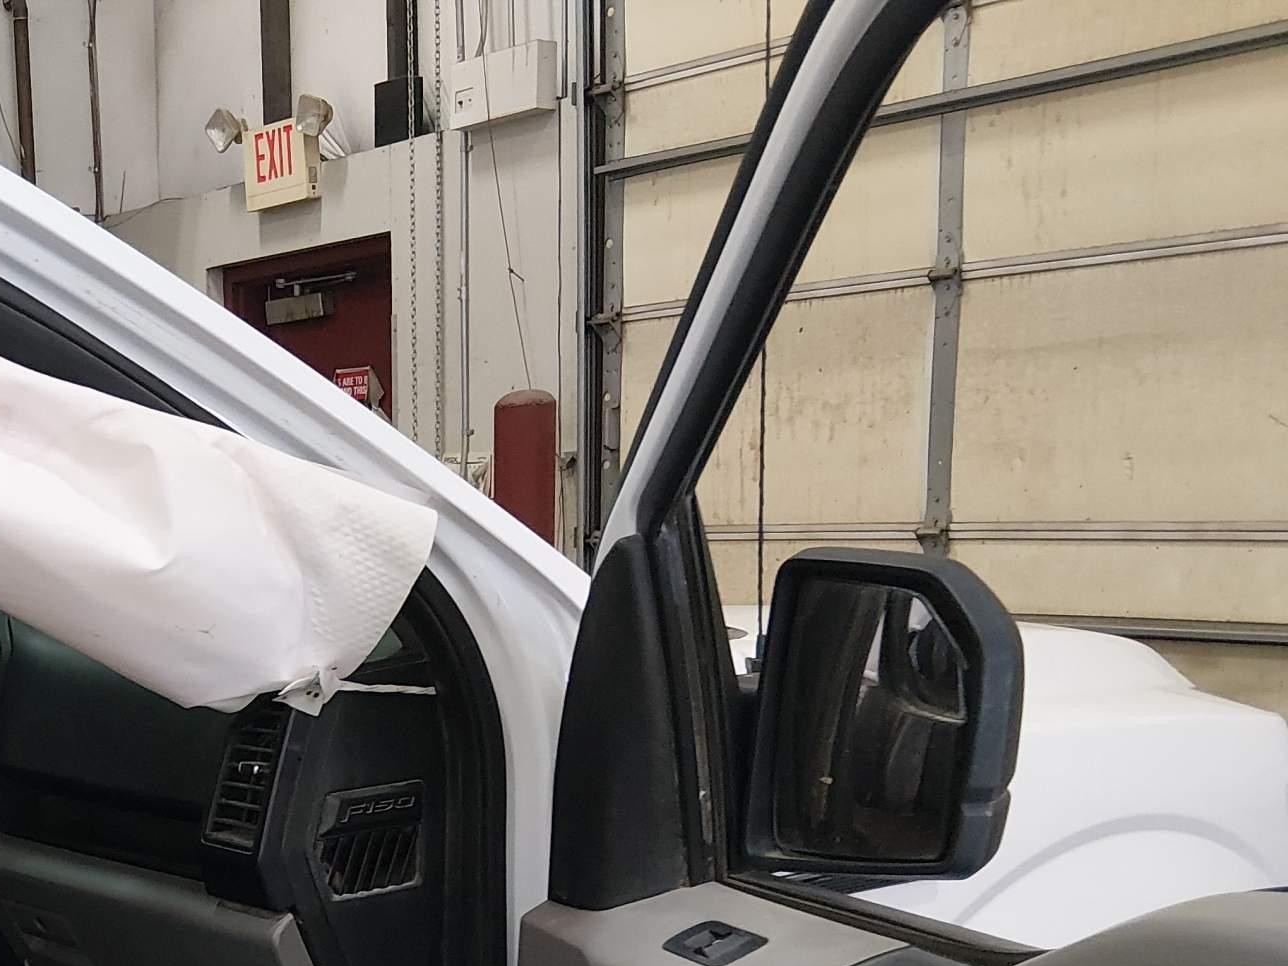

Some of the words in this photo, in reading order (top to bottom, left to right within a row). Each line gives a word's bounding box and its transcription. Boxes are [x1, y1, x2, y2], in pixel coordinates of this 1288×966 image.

[254, 124, 293, 183] EXIT
[342, 376, 354, 387] ARE
[355, 375, 363, 385] TO
